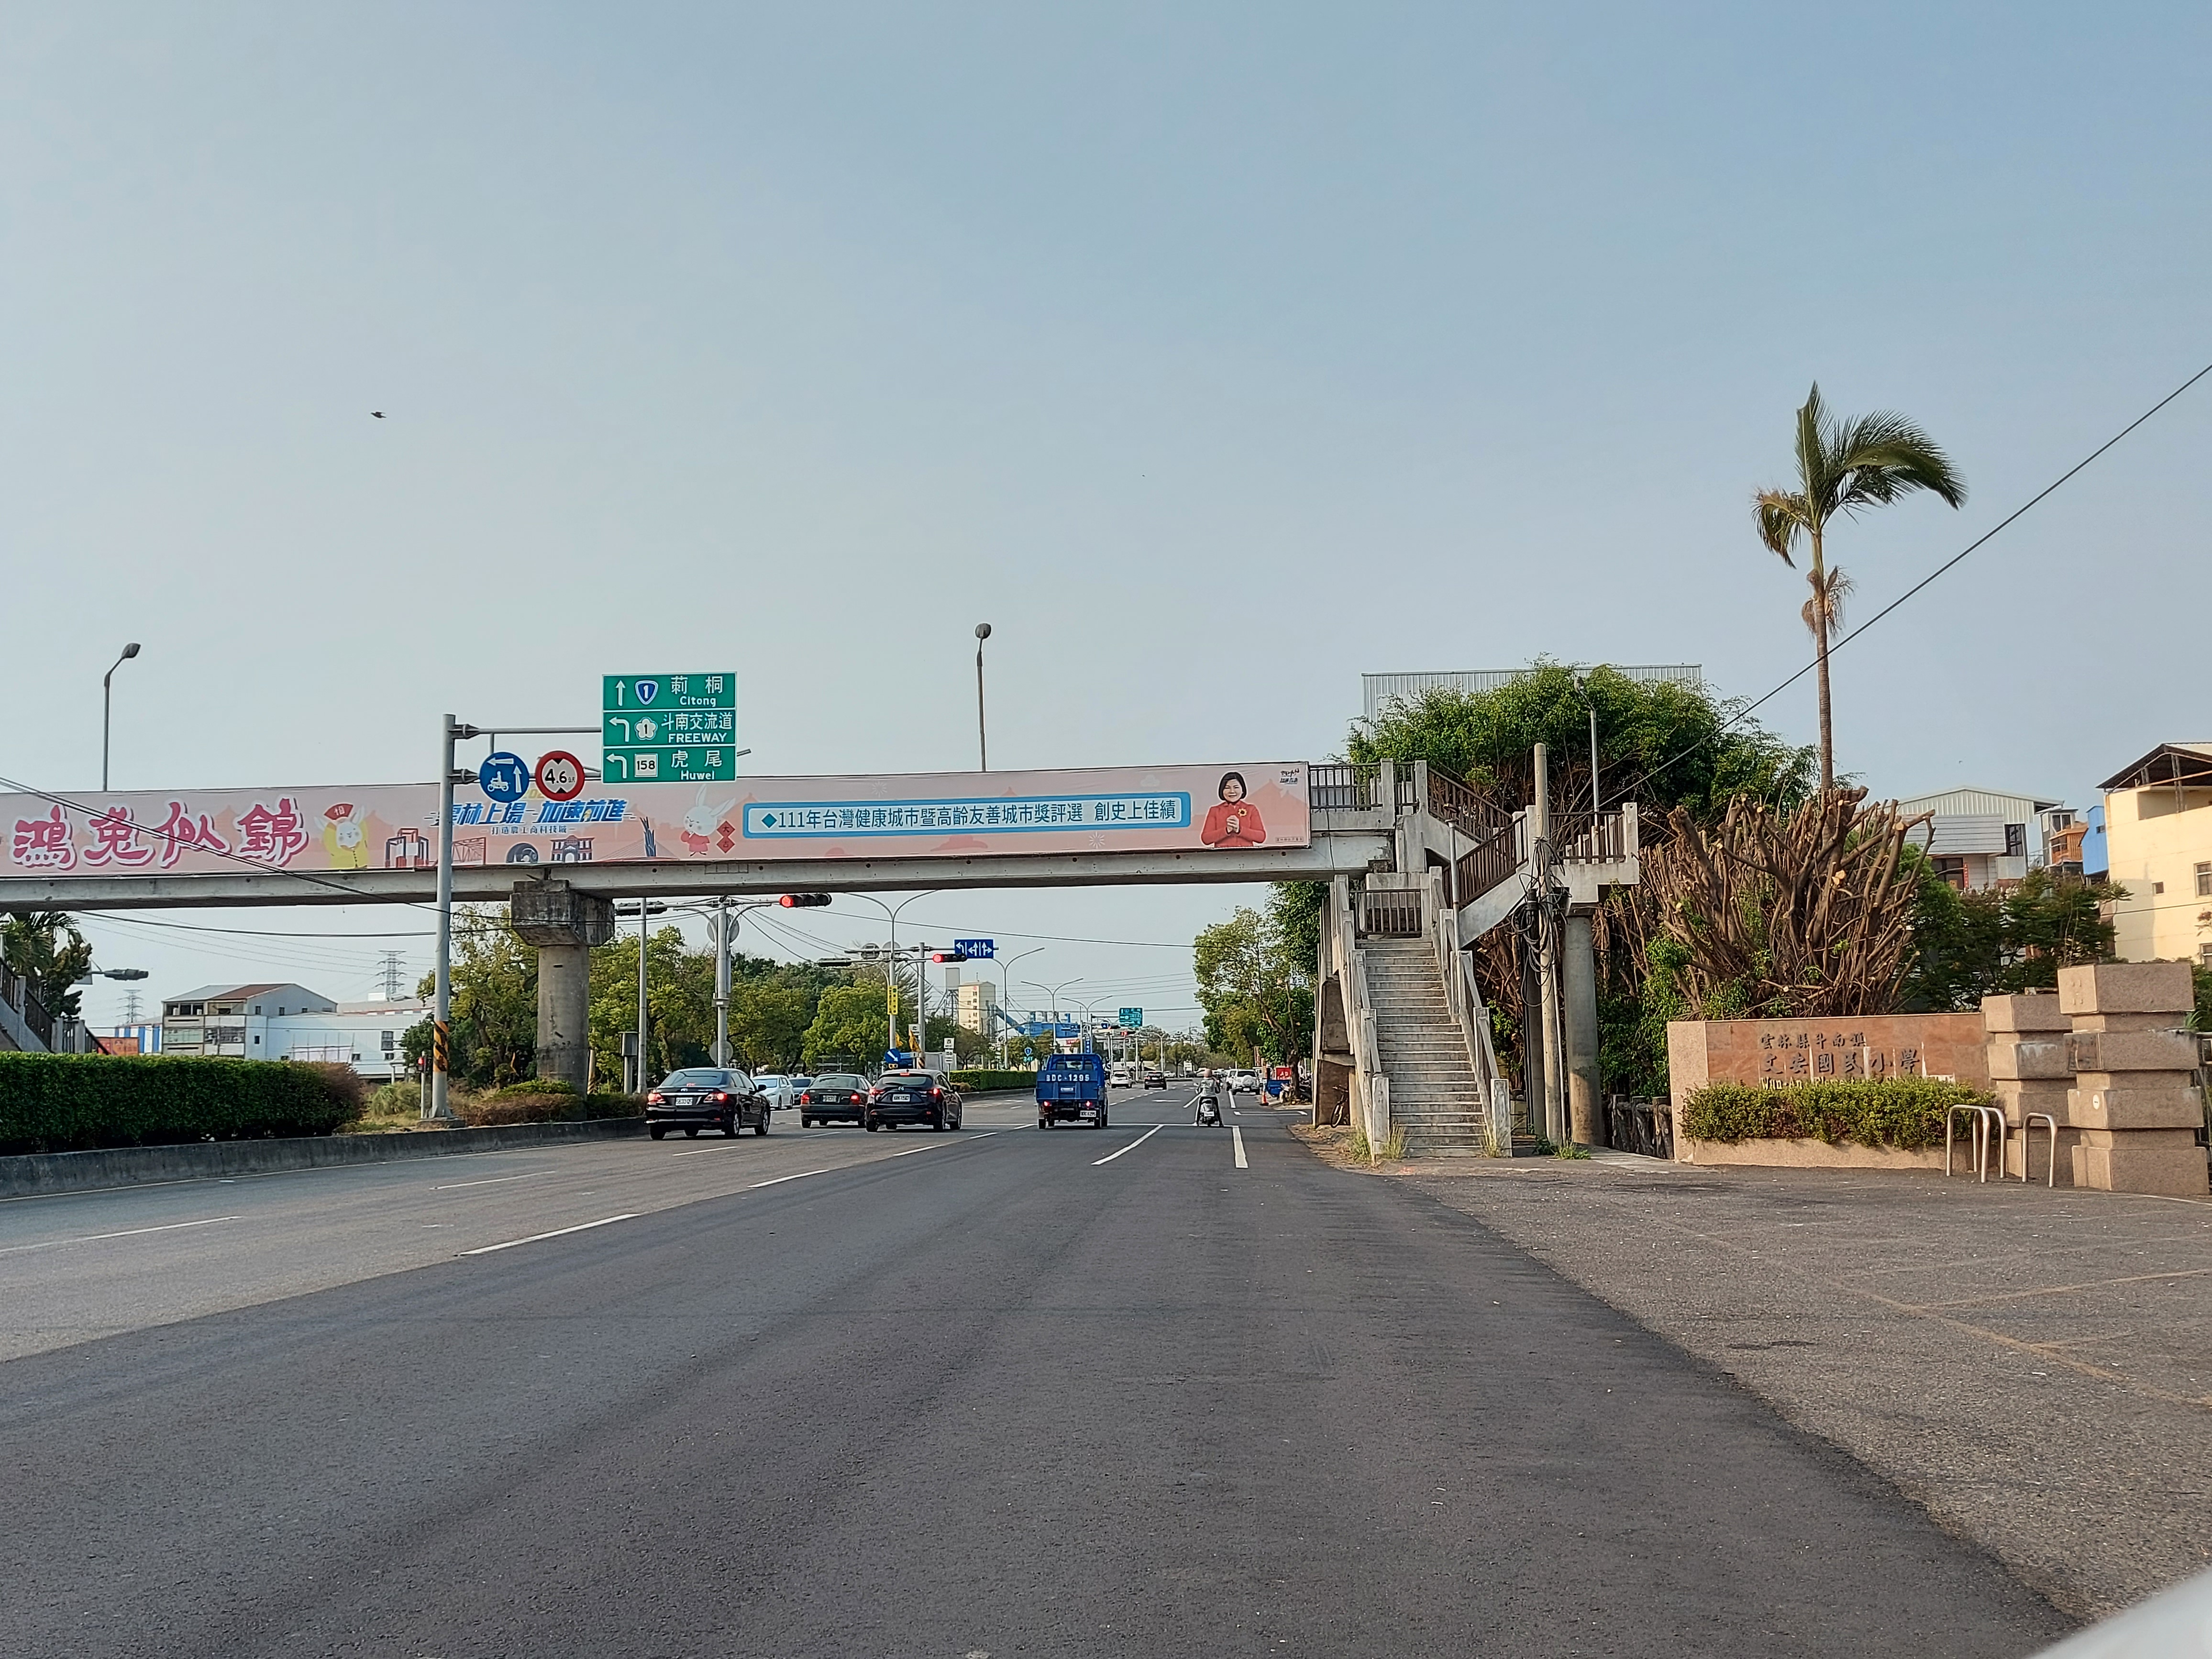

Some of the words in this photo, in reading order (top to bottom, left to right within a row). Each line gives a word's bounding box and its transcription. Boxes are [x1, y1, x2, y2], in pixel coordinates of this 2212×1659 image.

[671, 675, 723, 694] 莿桐
[643, 685, 648, 699] 1
[679, 696, 716, 707] Citong
[661, 712, 732, 730] 斗南交流道
[644, 724, 648, 734] 1
[668, 733, 727, 743] FREEWAY
[637, 760, 655, 770] 158
[671, 750, 722, 768] 虎尾
[545, 768, 567, 784] 4.6
[681, 770, 715, 780] Huwei
[778, 803, 1083, 829] 111年台灣健康城市暨高齡友善城市獎評選
[1095, 800, 1175, 821] 創史上佳績
